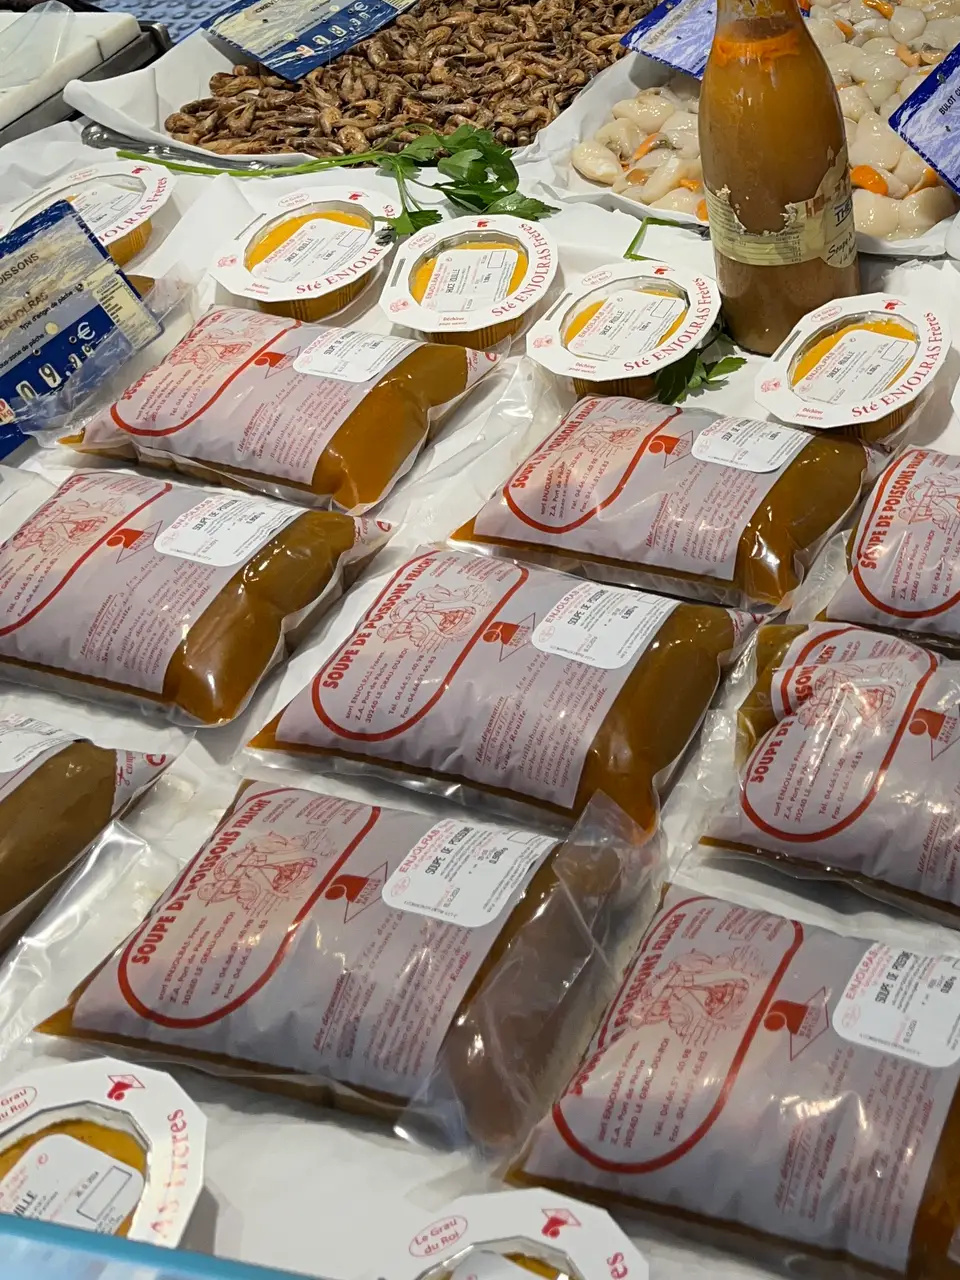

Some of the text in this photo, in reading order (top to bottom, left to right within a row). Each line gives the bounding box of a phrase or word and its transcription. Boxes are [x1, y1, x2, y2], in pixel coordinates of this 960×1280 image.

[938, 95, 956, 115] BULOT
[491, 223, 551, 317] Sté ENJOLRAS Frères
[296, 281, 322, 295] Sté
[624, 277, 713, 372] Sté ENJOLRAS Frères
[851, 311, 944, 418] Sté ENJOLRAS Frères
[322, 647, 360, 690] SOUPE
[353, 627, 372, 649] DE
[364, 582, 413, 630] POISSONS
[350, 668, 374, 705] ENJOLRAS
[365, 698, 378, 724] 30240
[375, 690, 382, 699] LE
[750, 719, 795, 784] SOUPE DE
[399, 829, 440, 873] ENJOLRAS
[425, 854, 444, 876] SOUPE
[439, 843, 453, 856] DE
[131, 798, 272, 965] SOUPE DE POISSONS FRAICHE
[1, 1088, 28, 1107] Grau
[10, 1099, 29, 1115] Roi
[414, 1218, 458, 1246] Le Grau
[424, 1230, 459, 1255] du Roi
